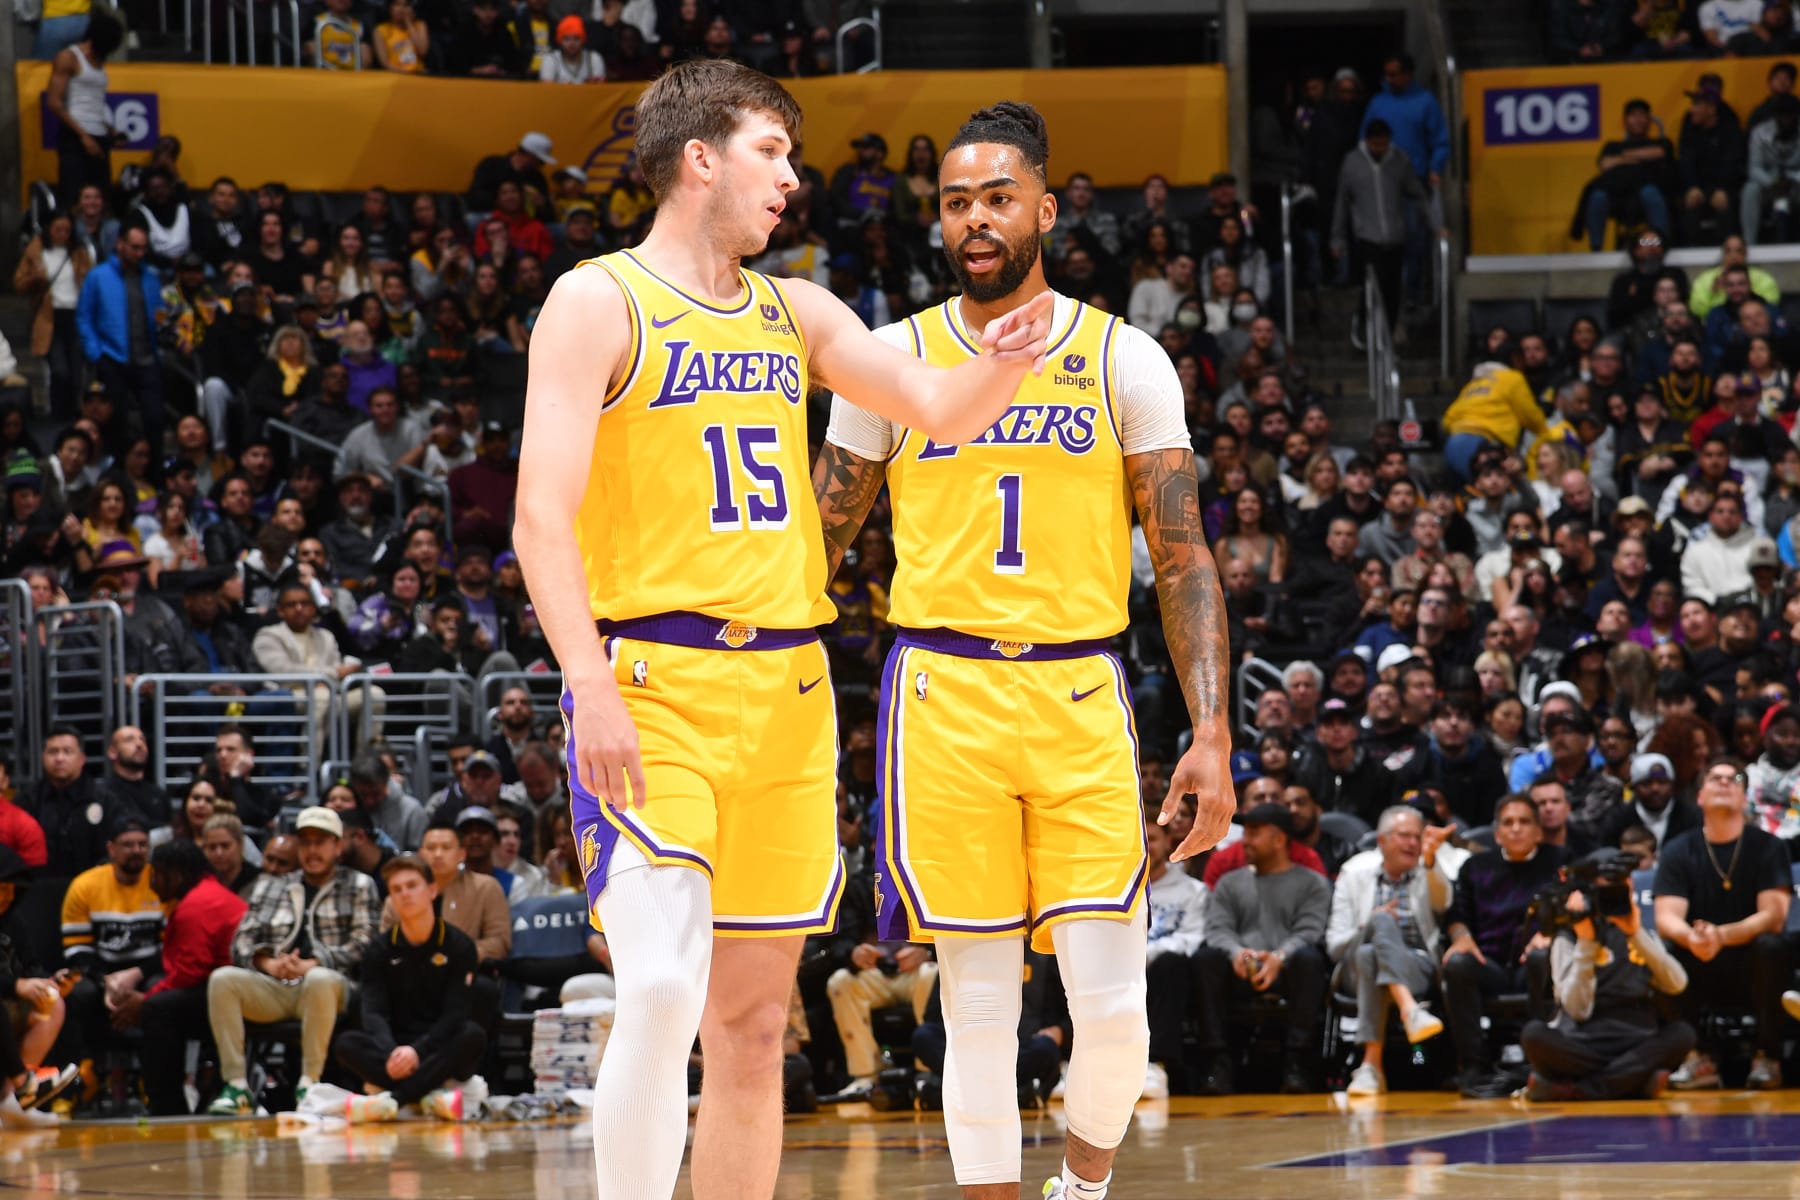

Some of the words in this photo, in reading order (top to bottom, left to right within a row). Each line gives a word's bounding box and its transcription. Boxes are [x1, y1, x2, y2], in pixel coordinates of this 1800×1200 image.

[1494, 91, 1590, 136] 106
[648, 340, 800, 409] LAKERS
[1054, 374, 1095, 390] bibigo
[701, 423, 791, 533] 15
[993, 473, 1025, 574] 1
